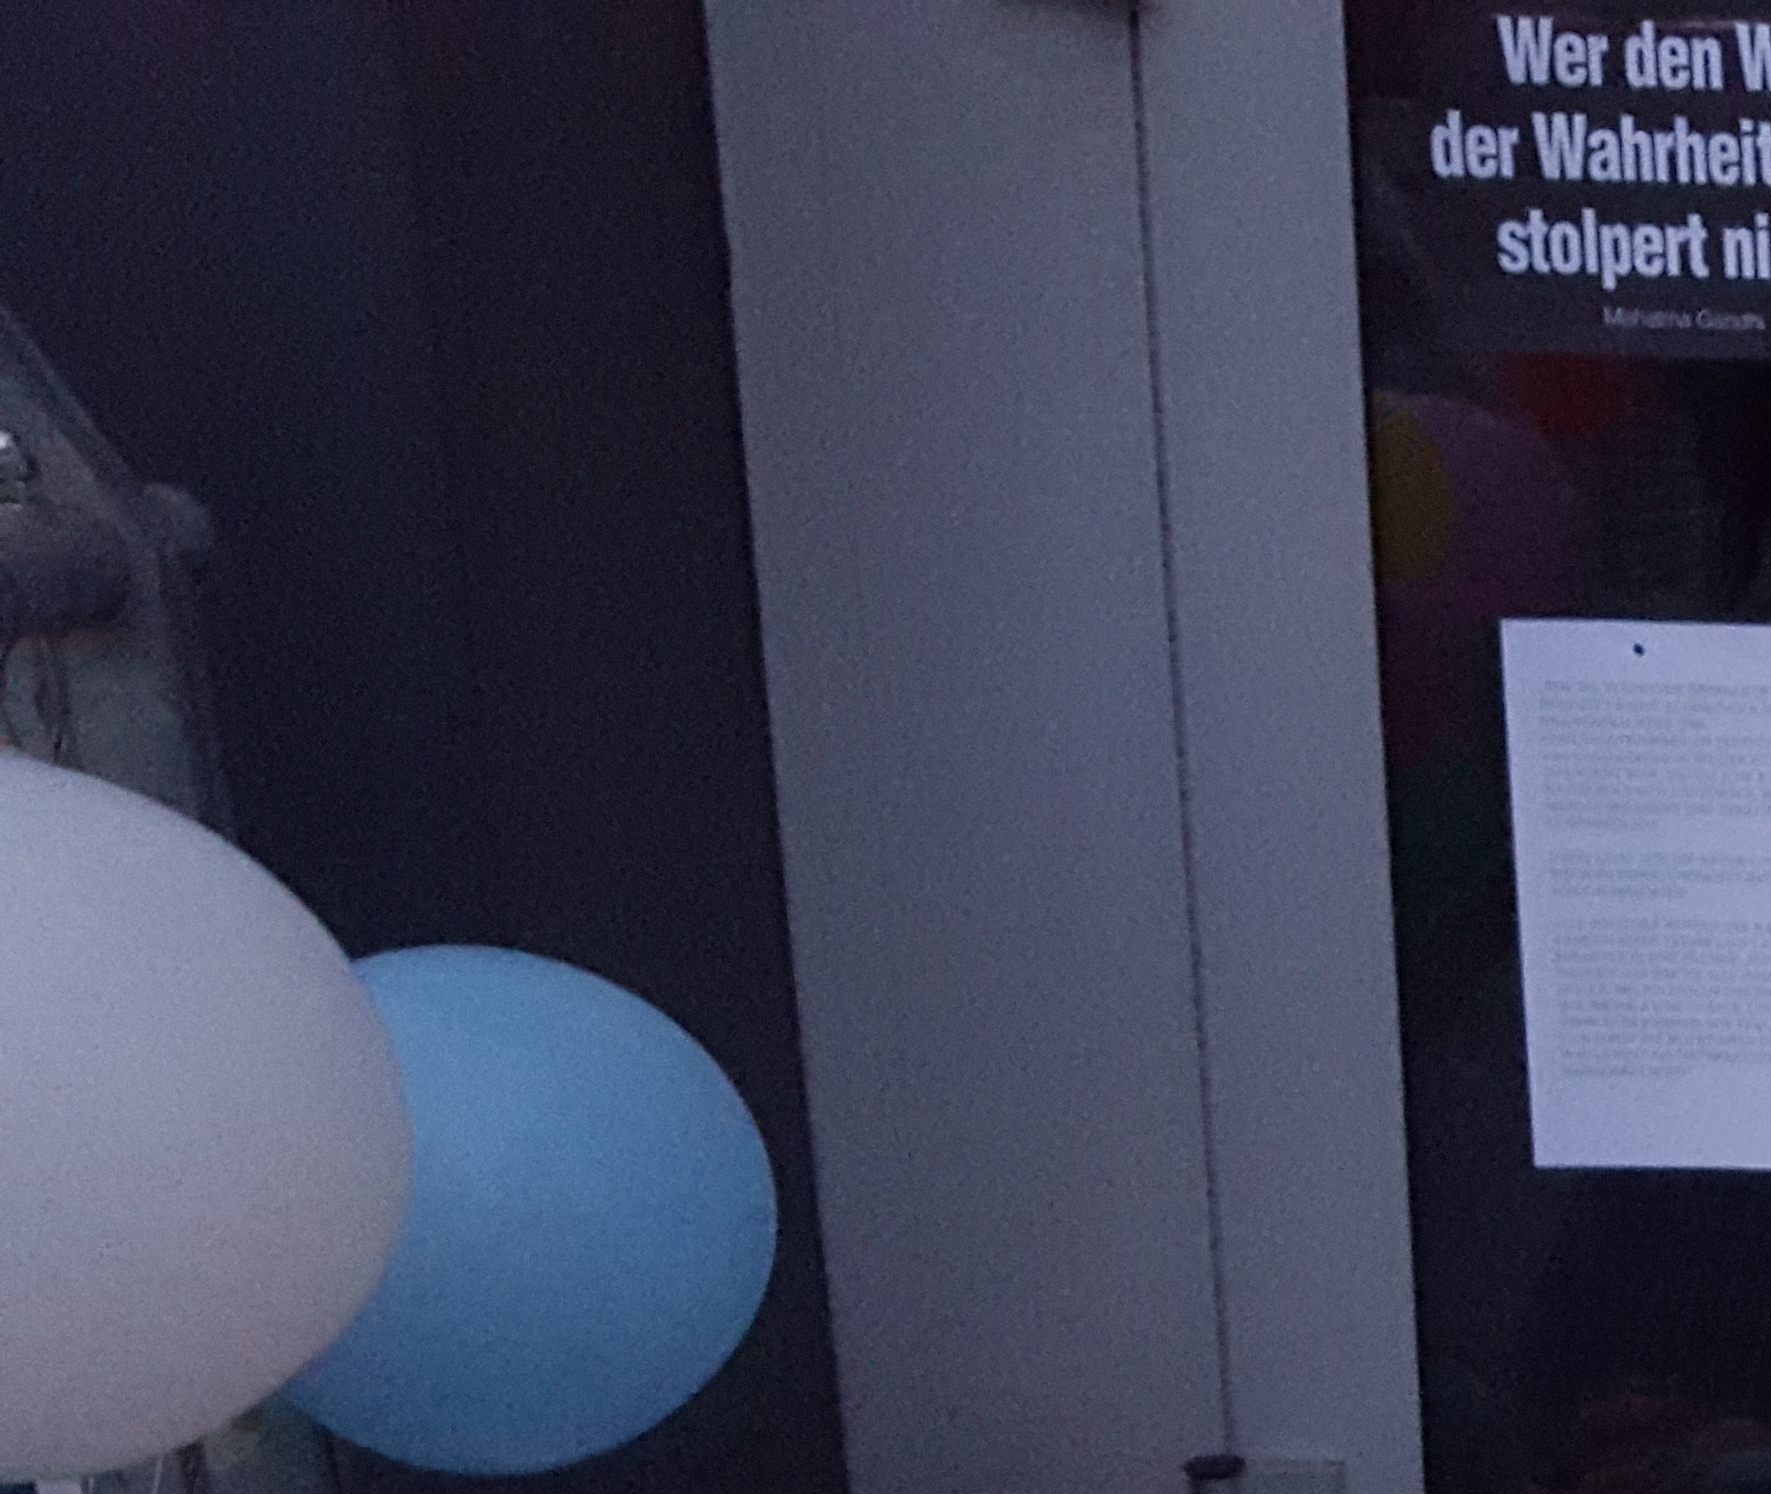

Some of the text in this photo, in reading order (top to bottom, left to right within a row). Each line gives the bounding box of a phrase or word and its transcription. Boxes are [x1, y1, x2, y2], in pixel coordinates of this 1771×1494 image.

[1495, 15, 1608, 87] Wer
[1623, 20, 1724, 92] den
[1430, 109, 1519, 179] der
[1498, 208, 1709, 290] stolpert
